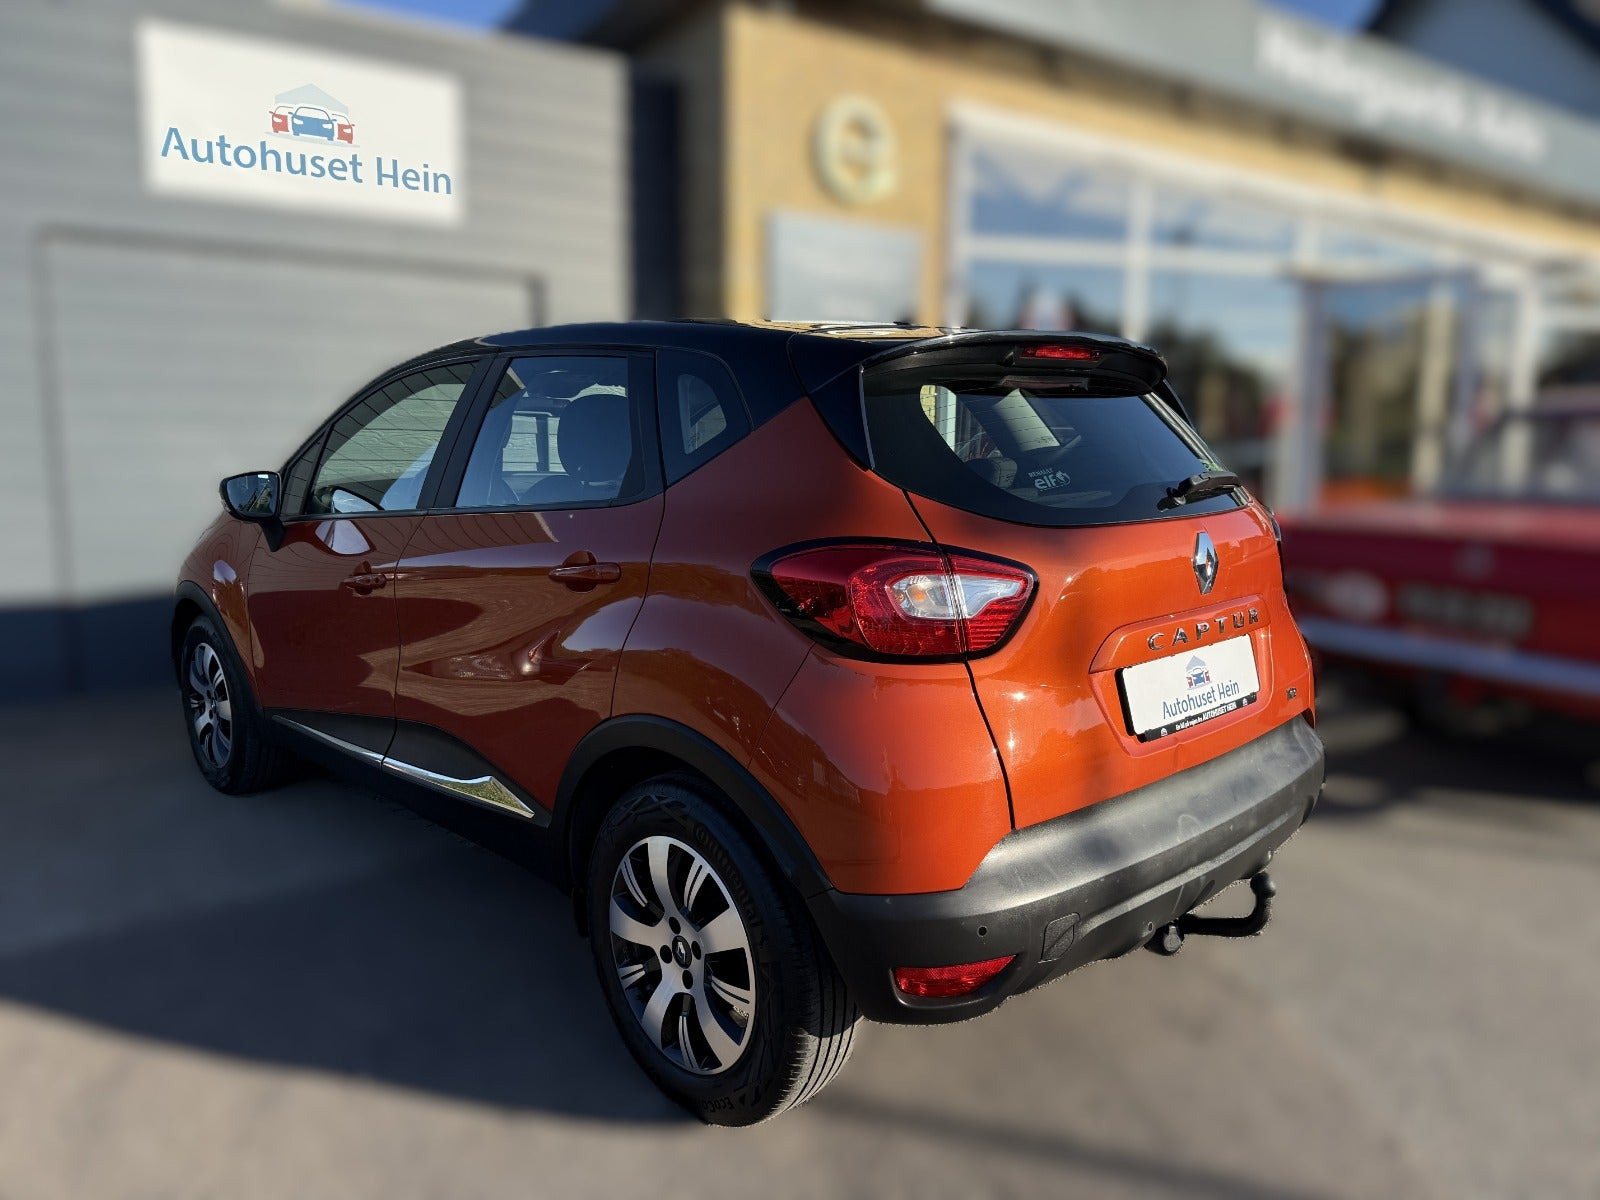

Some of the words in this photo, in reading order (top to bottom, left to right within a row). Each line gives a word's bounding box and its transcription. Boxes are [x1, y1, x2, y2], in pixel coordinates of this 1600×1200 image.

[161, 127, 363, 184] Autohuset
[376, 157, 452, 195] Hein
[1148, 608, 1258, 650] CAPTUR
[1163, 687, 1217, 719] Autohuset
[1218, 680, 1239, 700] Hein
